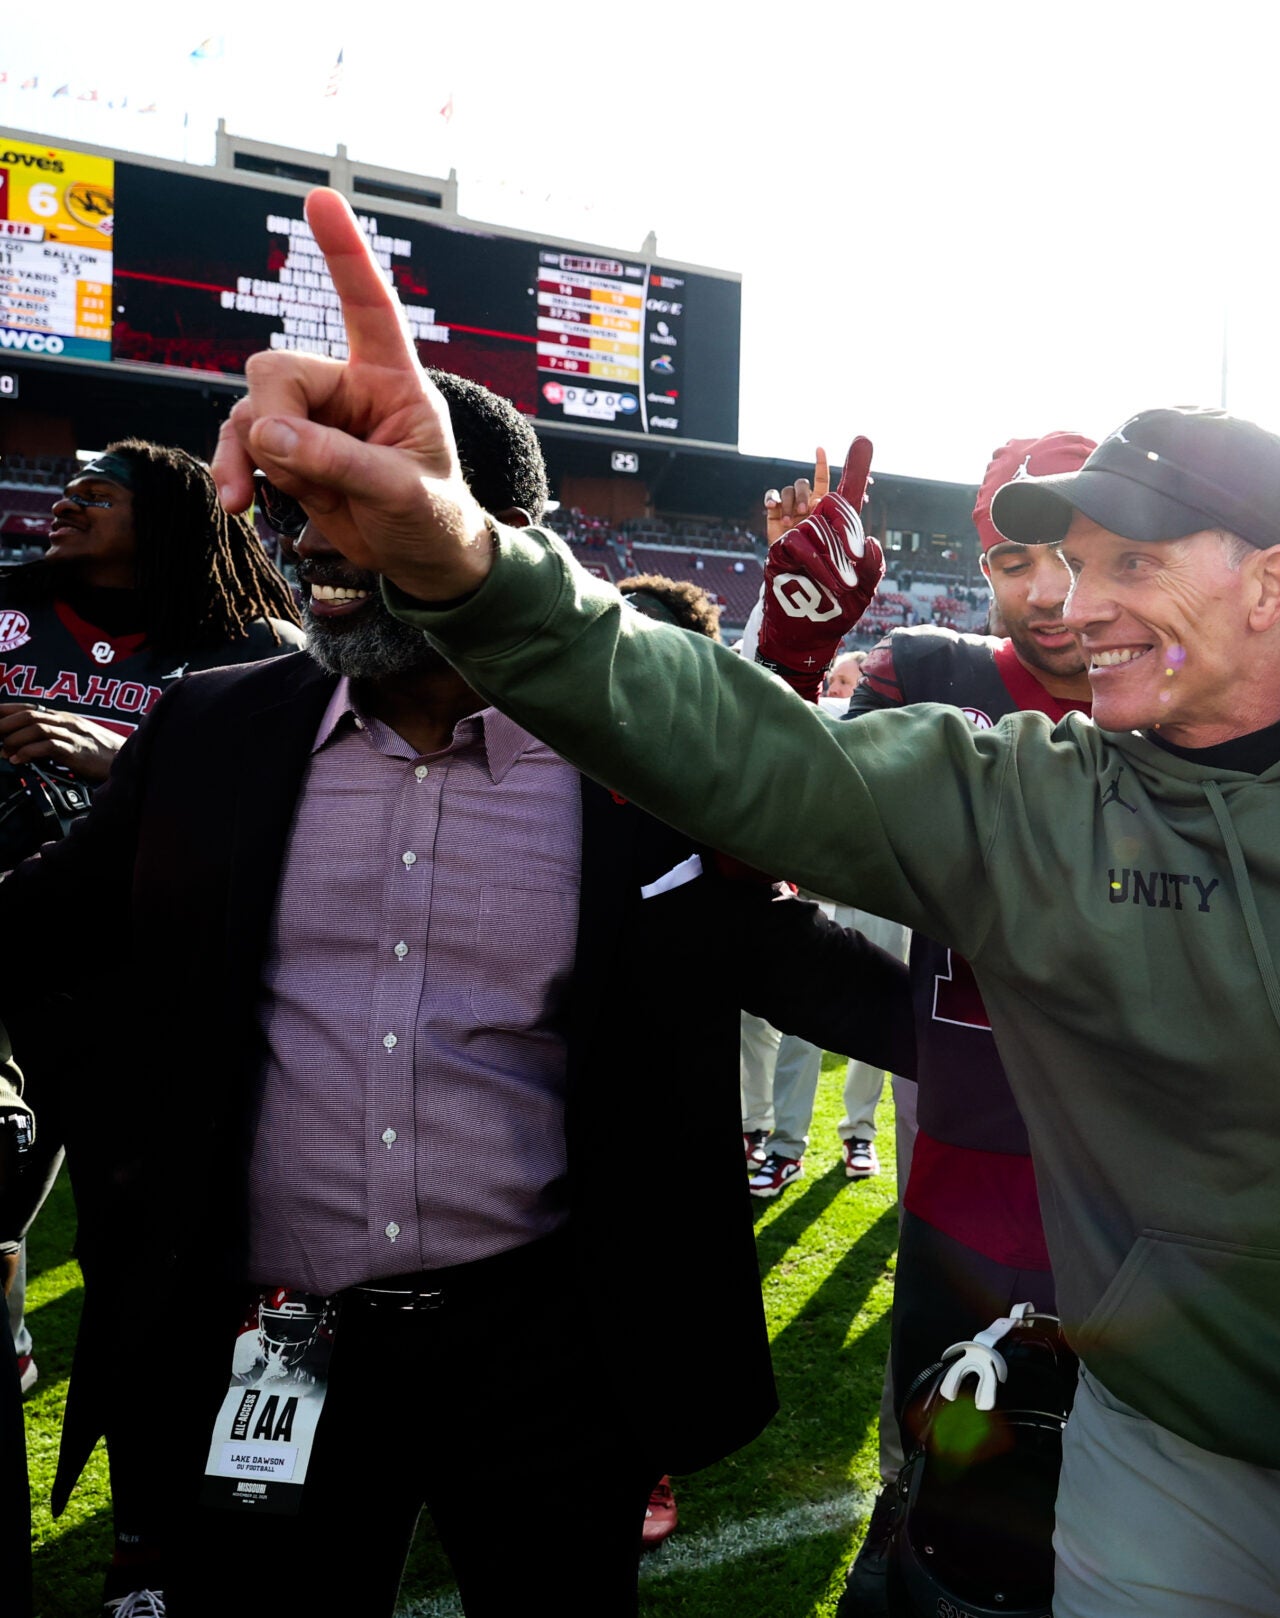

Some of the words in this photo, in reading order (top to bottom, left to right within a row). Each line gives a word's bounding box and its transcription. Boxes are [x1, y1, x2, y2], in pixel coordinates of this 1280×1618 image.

[28, 182, 59, 217] 6
[43, 249, 73, 260] BALL
[79, 254, 97, 264] ON
[615, 453, 635, 470] 25
[772, 571, 842, 623] OU
[91, 641, 115, 664] OU
[1107, 867, 1220, 913] UNITY
[234, 1394, 257, 1436] ALL-ACCESS
[252, 1394, 299, 1442] AA
[230, 1454, 251, 1463] LAKE
[252, 1456, 285, 1466] DAWSON
[245, 1464, 275, 1473] FOOTBALL
